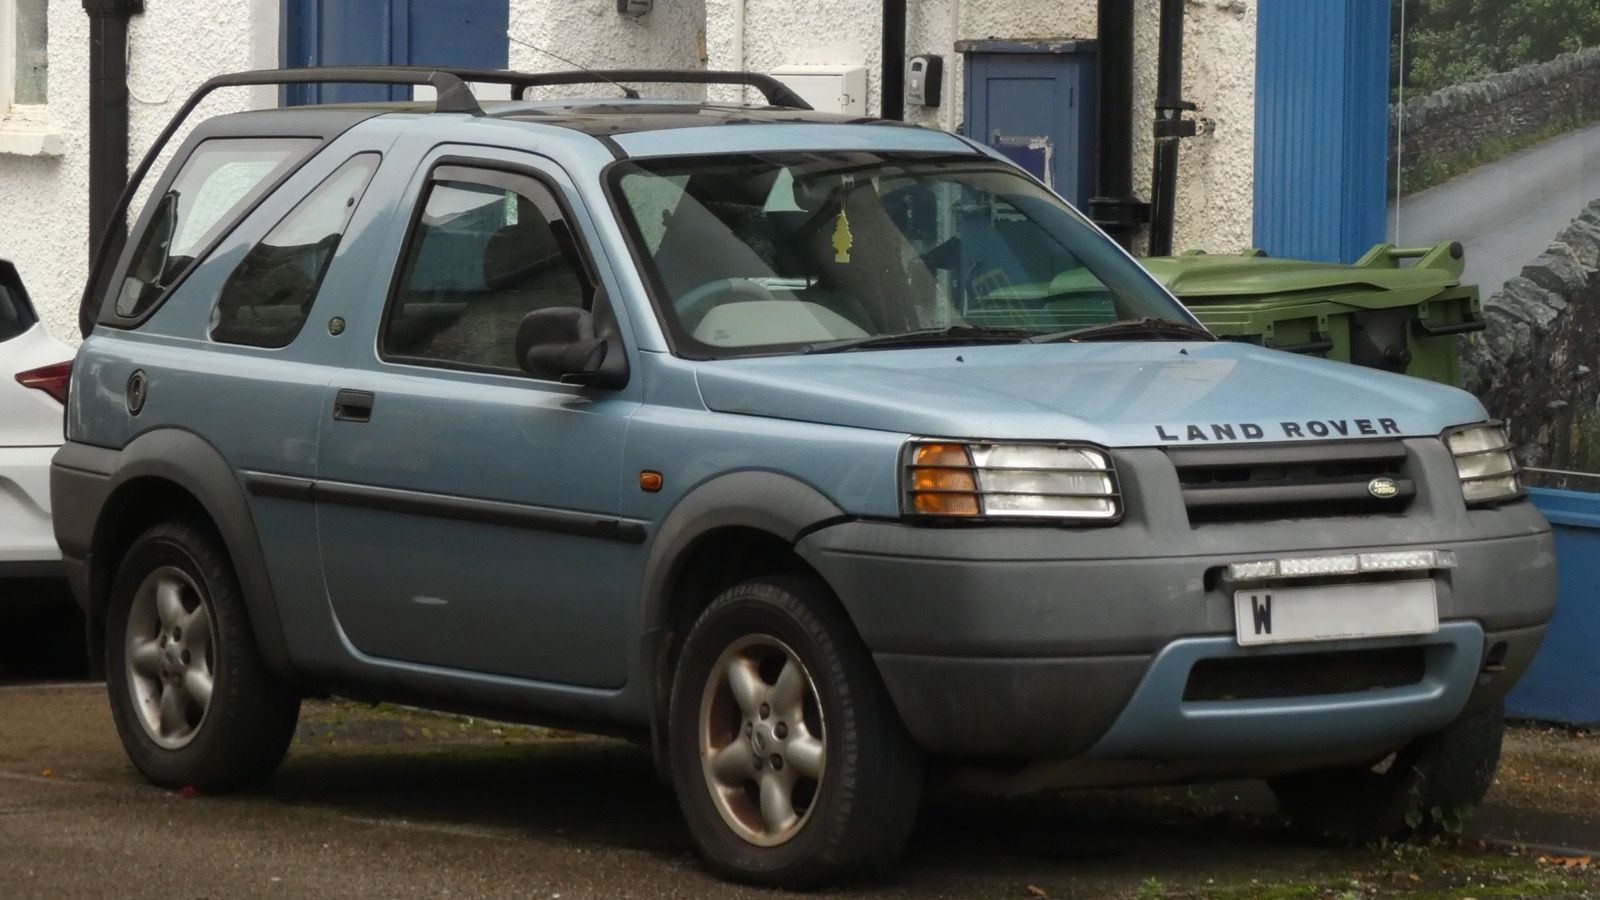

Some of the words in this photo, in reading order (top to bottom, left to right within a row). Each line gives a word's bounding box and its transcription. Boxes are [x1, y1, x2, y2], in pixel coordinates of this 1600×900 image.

[1155, 423, 1264, 441] LAND
[1280, 418, 1402, 438] ROVER
[1251, 595, 1272, 635] W
